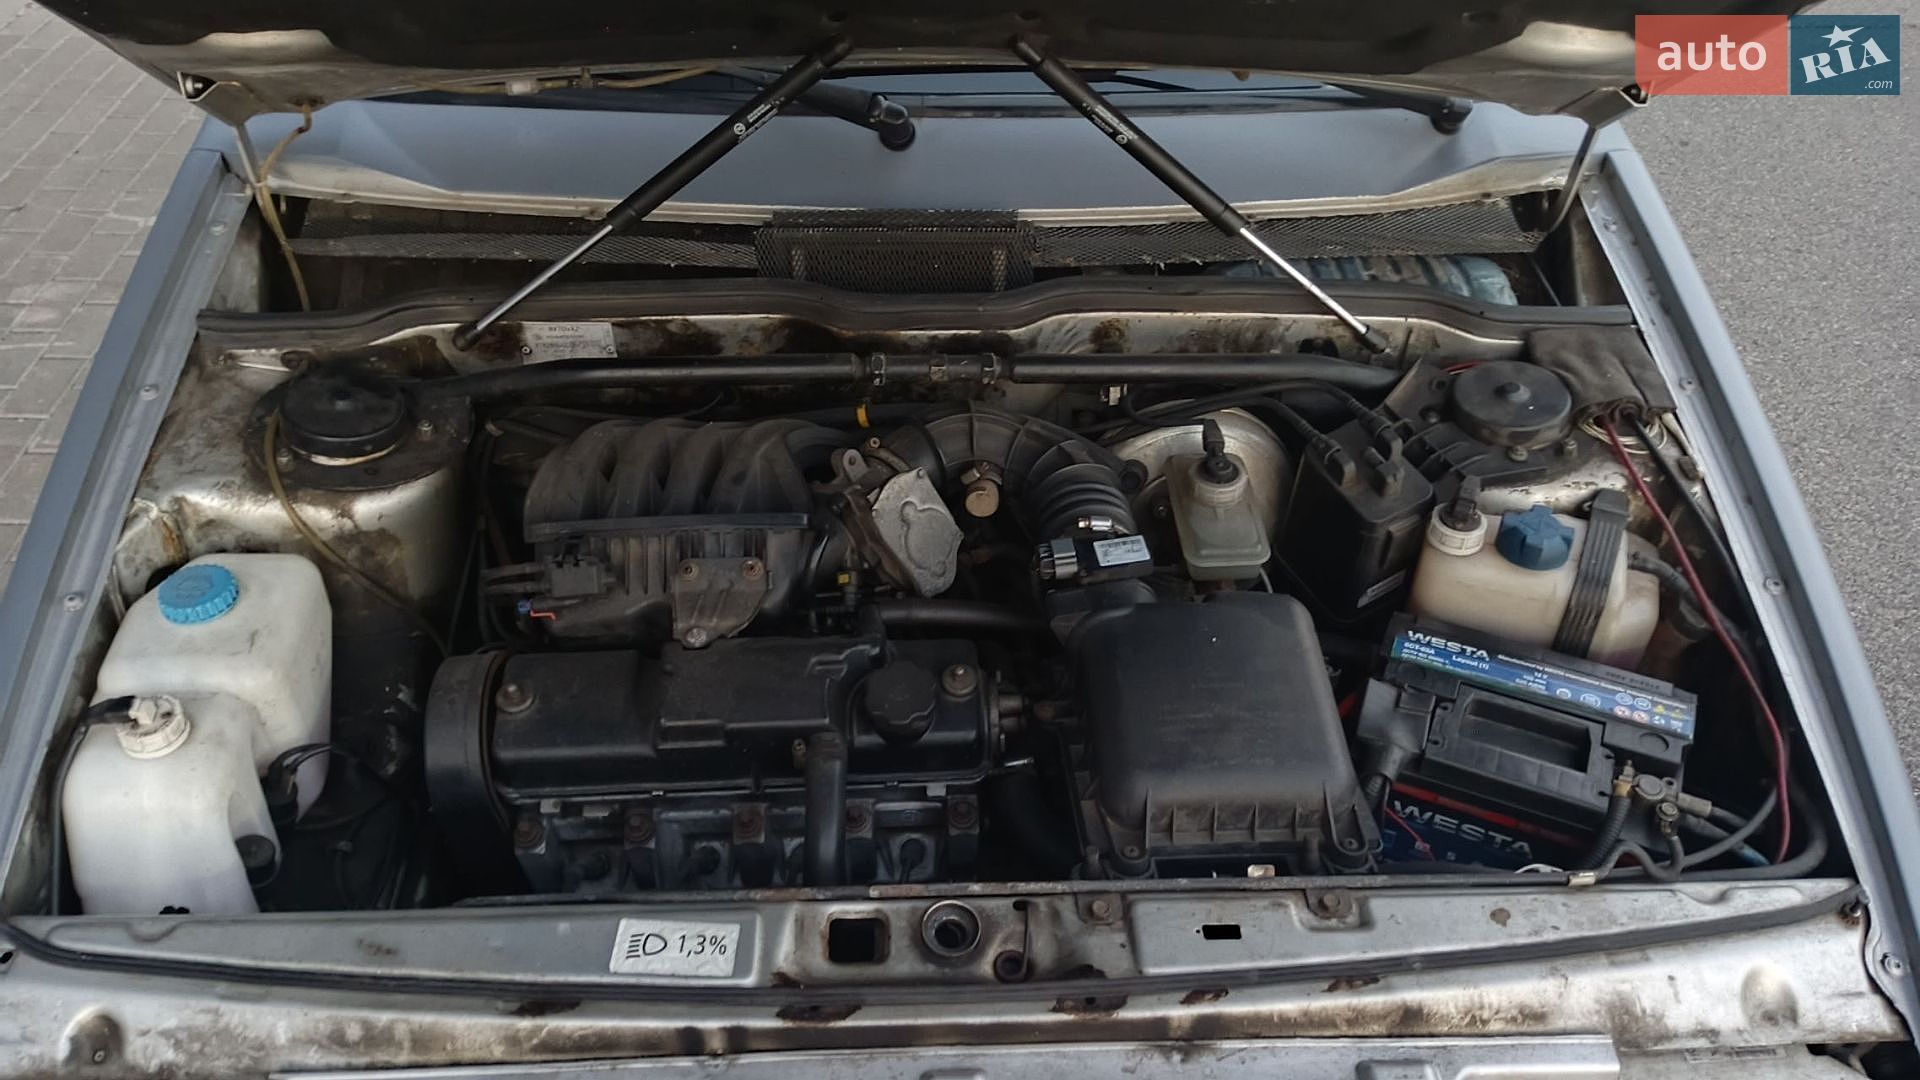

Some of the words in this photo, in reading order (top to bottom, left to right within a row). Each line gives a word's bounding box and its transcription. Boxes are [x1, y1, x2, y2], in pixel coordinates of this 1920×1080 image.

[1408, 630, 1490, 661] WESTA
[1393, 800, 1533, 860] WESTA
[678, 934, 727, 958] 1,3%
